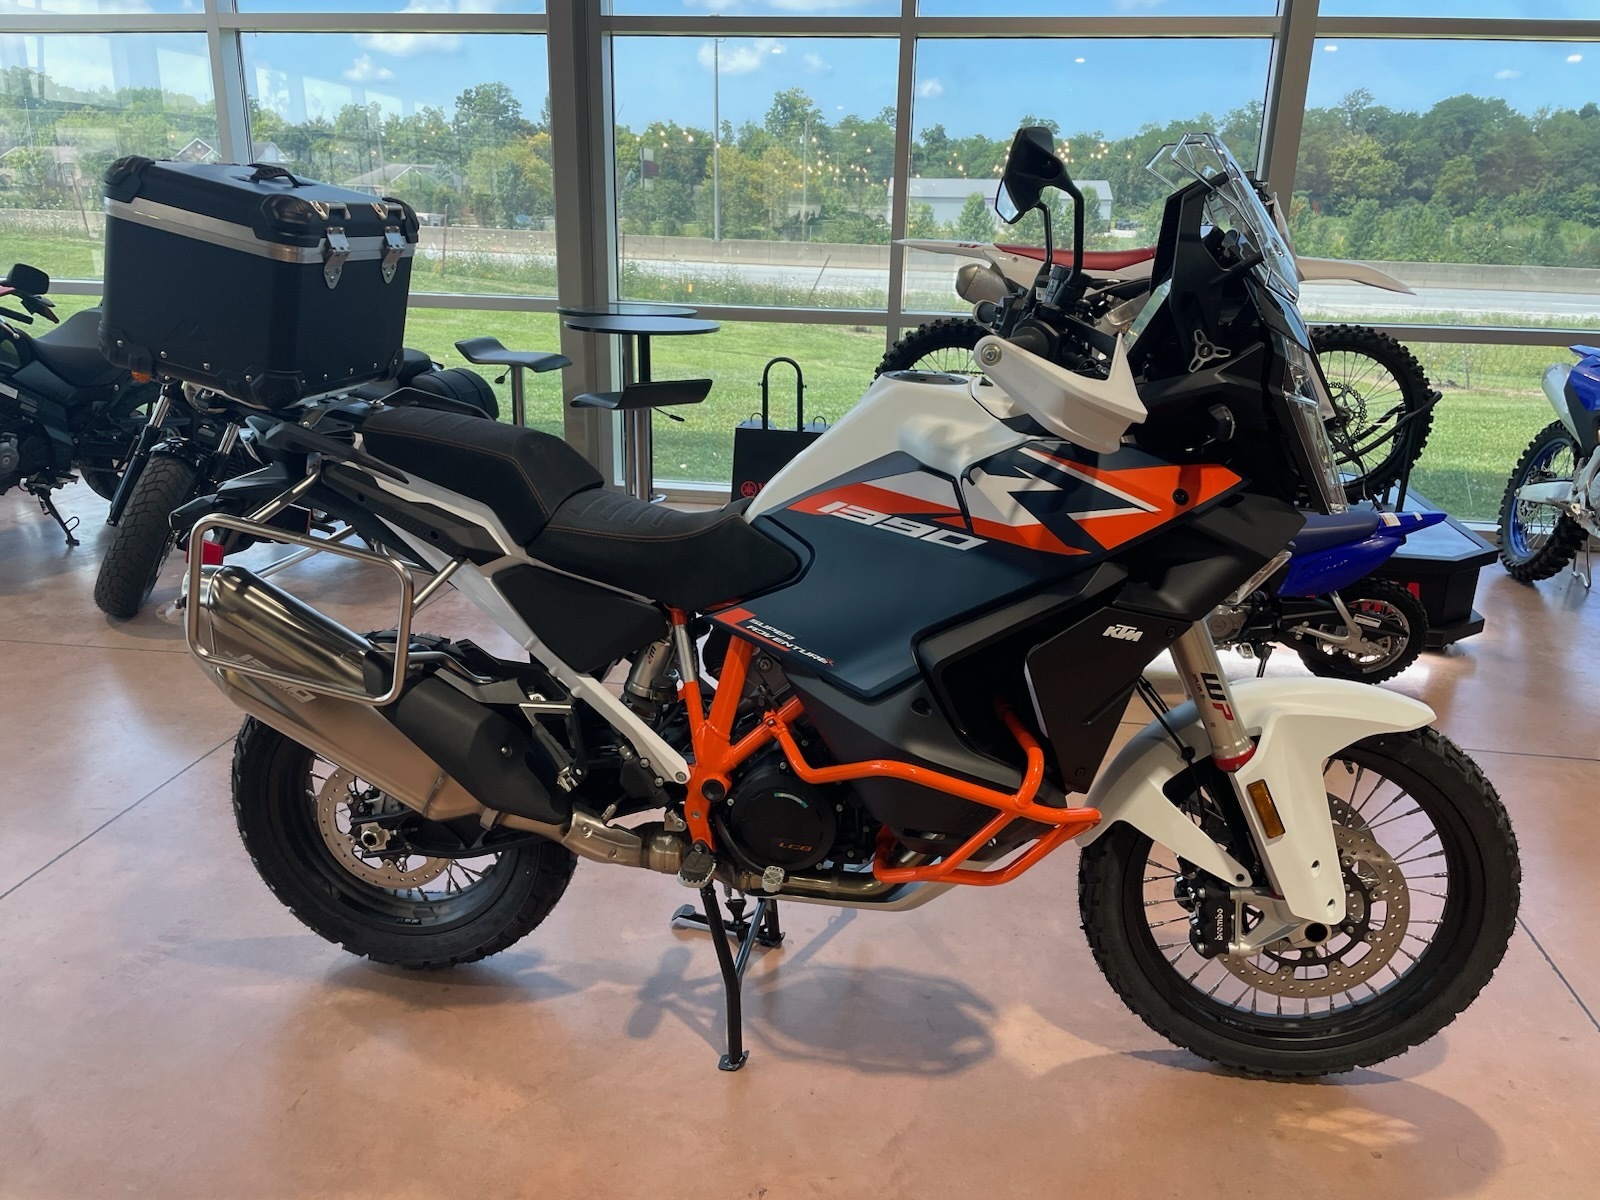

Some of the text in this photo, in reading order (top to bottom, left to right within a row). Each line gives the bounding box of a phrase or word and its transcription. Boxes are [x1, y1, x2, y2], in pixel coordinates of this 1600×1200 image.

[816, 500, 988, 551] 1390
[746, 625, 829, 664] ADVENTURE
[749, 618, 795, 640] SUPER
[1102, 624, 1143, 642] KTM
[1201, 672, 1234, 720] WP
[1213, 908, 1224, 941] brembo
